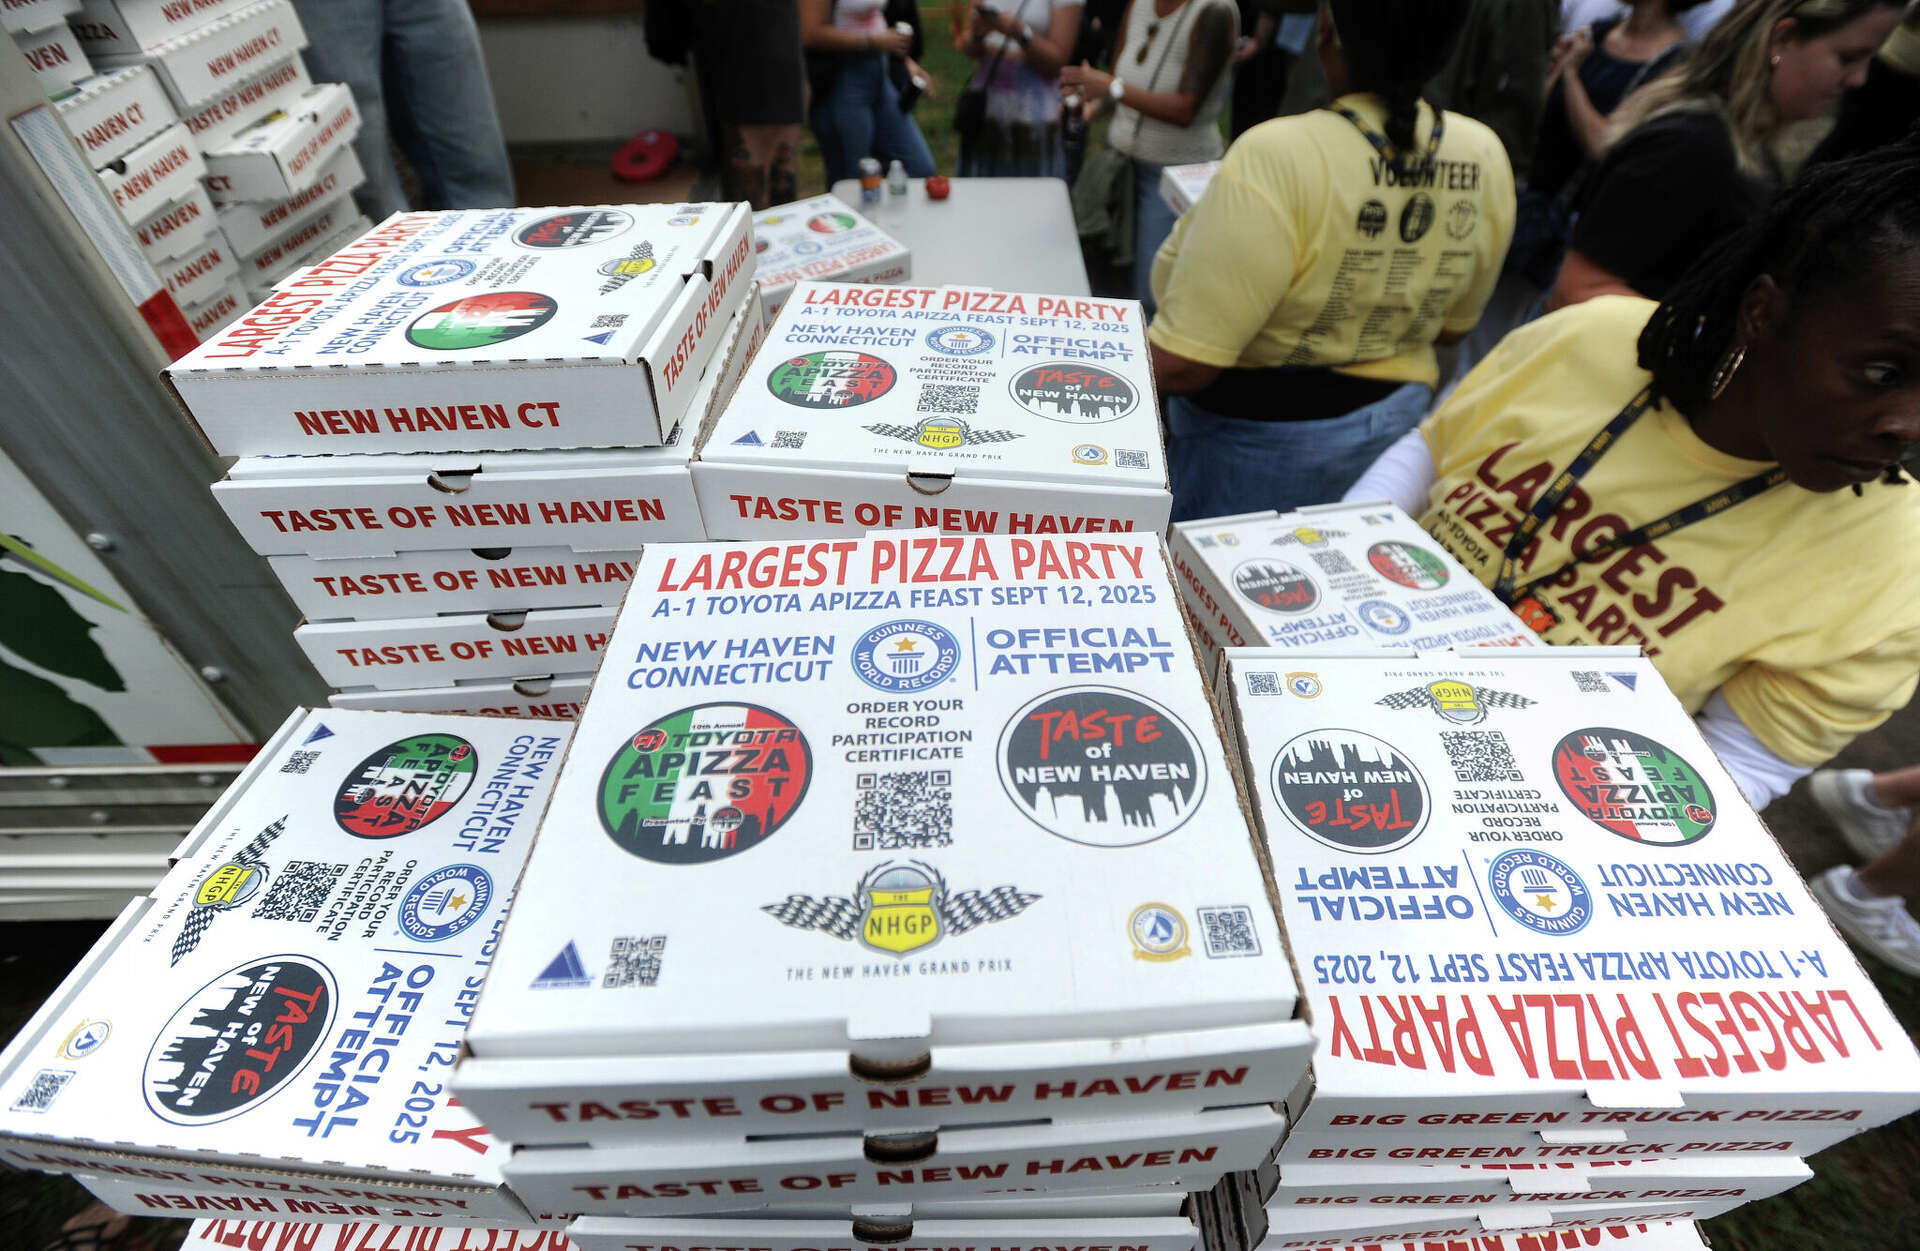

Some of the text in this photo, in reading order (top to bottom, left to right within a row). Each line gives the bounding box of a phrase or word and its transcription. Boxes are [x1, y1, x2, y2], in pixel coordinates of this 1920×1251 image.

[206, 27, 281, 78] NEW HAVEN CT
[184, 63, 298, 135] TASTE OF NEW HAVEN
[112, 145, 190, 208] F NEW HAVEN
[206, 176, 232, 192] CT
[260, 173, 338, 229] NEW HAVEN CT
[150, 201, 201, 241] HAVEN
[173, 248, 223, 288] HAVEN
[204, 215, 438, 358] LARGEST PIZZA PARTY
[663, 232, 750, 393] TASTE OF NEW HAVEN
[801, 306, 1131, 334] A-1 TOYOTA APIZZA FEAST SEPT 12, 2025
[804, 288, 1128, 323] LARGEST PIZZA PARTY
[785, 333, 914, 348] CONNECTICUT
[790, 323, 917, 338] NEW HAVEN
[1019, 388, 1128, 404] NEW HAVEN
[1031, 369, 1116, 389] TASTE
[1064, 384, 1082, 392] of
[294, 401, 561, 436] NEW HAVEN CT
[261, 498, 666, 534] TASTE OF NEW HAVEN
[730, 494, 844, 522] TASTE
[854, 502, 903, 529] OF
[914, 507, 998, 535] NEW
[1444, 481, 1543, 574] PIZZA
[1448, 520, 1491, 568] TOYOTA
[1475, 440, 1727, 639] LARGEST
[313, 571, 428, 598] TASTE
[432, 568, 480, 593] OF
[487, 564, 568, 589] NEW
[656, 537, 1144, 593] LARGEST PIZZA PARTY
[651, 584, 1157, 618] A-1 TOYOTA APIZZA FEAST SEPT 12, 2025
[1173, 552, 1220, 617] LARGEST
[868, 622, 945, 645] GUINNESS
[986, 627, 1172, 650] OFFICIAL
[1269, 612, 1347, 637] ATTEMPT
[1274, 624, 1359, 647] OFFICIAL
[635, 640, 717, 664] NEW
[724, 635, 836, 660] HAVEN
[988, 651, 1176, 677] ATTEMPT
[627, 660, 832, 690] CONNECTICUT
[858, 647, 954, 691] WORLD RECORDS
[846, 699, 964, 714] ORDER YOUR
[865, 715, 940, 729] RECORD
[672, 728, 799, 748] TOYOTA
[832, 729, 973, 747] PARTICIPATION
[1029, 709, 1162, 760] TASTE
[1085, 742, 1112, 759] of
[520, 736, 561, 781] NEW
[623, 748, 791, 780] APIZZA
[845, 746, 964, 763] CERTIFICATE
[363, 743, 432, 827] FEAST
[380, 743, 451, 828] APIZZA
[617, 777, 789, 805] FEAST
[1015, 763, 1190, 784] NEW HAVEN
[1284, 771, 1413, 785] NEW HAVEN
[404, 764, 457, 831] TOYOTA
[451, 734, 535, 853] CONNECTICUT
[1305, 787, 1413, 831] TASTE
[1343, 788, 1364, 802] of
[477, 783, 536, 855] HAVEN
[1295, 865, 1458, 891] ATTEMPT
[1597, 863, 1773, 887] CONNECTICUT
[316, 857, 372, 933] CERTIFICATE
[327, 850, 393, 941] PARTICIPATION
[358, 871, 396, 920] RECORD
[361, 859, 417, 939] ORDER YOUR
[1297, 894, 1475, 921] OFFICIAL
[1606, 891, 1795, 917] NEW HAVEN
[869, 914, 932, 937] NHGP
[787, 958, 1013, 982] THE NEW HAVEN GRAND PRIX
[1313, 949, 1828, 984] A-1 TOYOTA APIZZA FEAST SEPT 12, 2025
[175, 966, 282, 1107] NEW HAVEN
[231, 985, 324, 1096] TASTE
[241, 1022, 263, 1047] of
[292, 961, 404, 1137] ATTEMPT
[321, 964, 435, 1138] OFFICIAL
[1328, 989, 1885, 1081] LARGEST PIZZA PARTY
[529, 1065, 1250, 1124] TASTE OF NEW HAVEN
[1330, 1109, 1863, 1126] BIG GREEN TRUCK PIZZA
[1307, 1141, 1794, 1159] BIG GREEN TRUCK PIZZA
[573, 1146, 1219, 1201] TASTE OF NEW HAVEN
